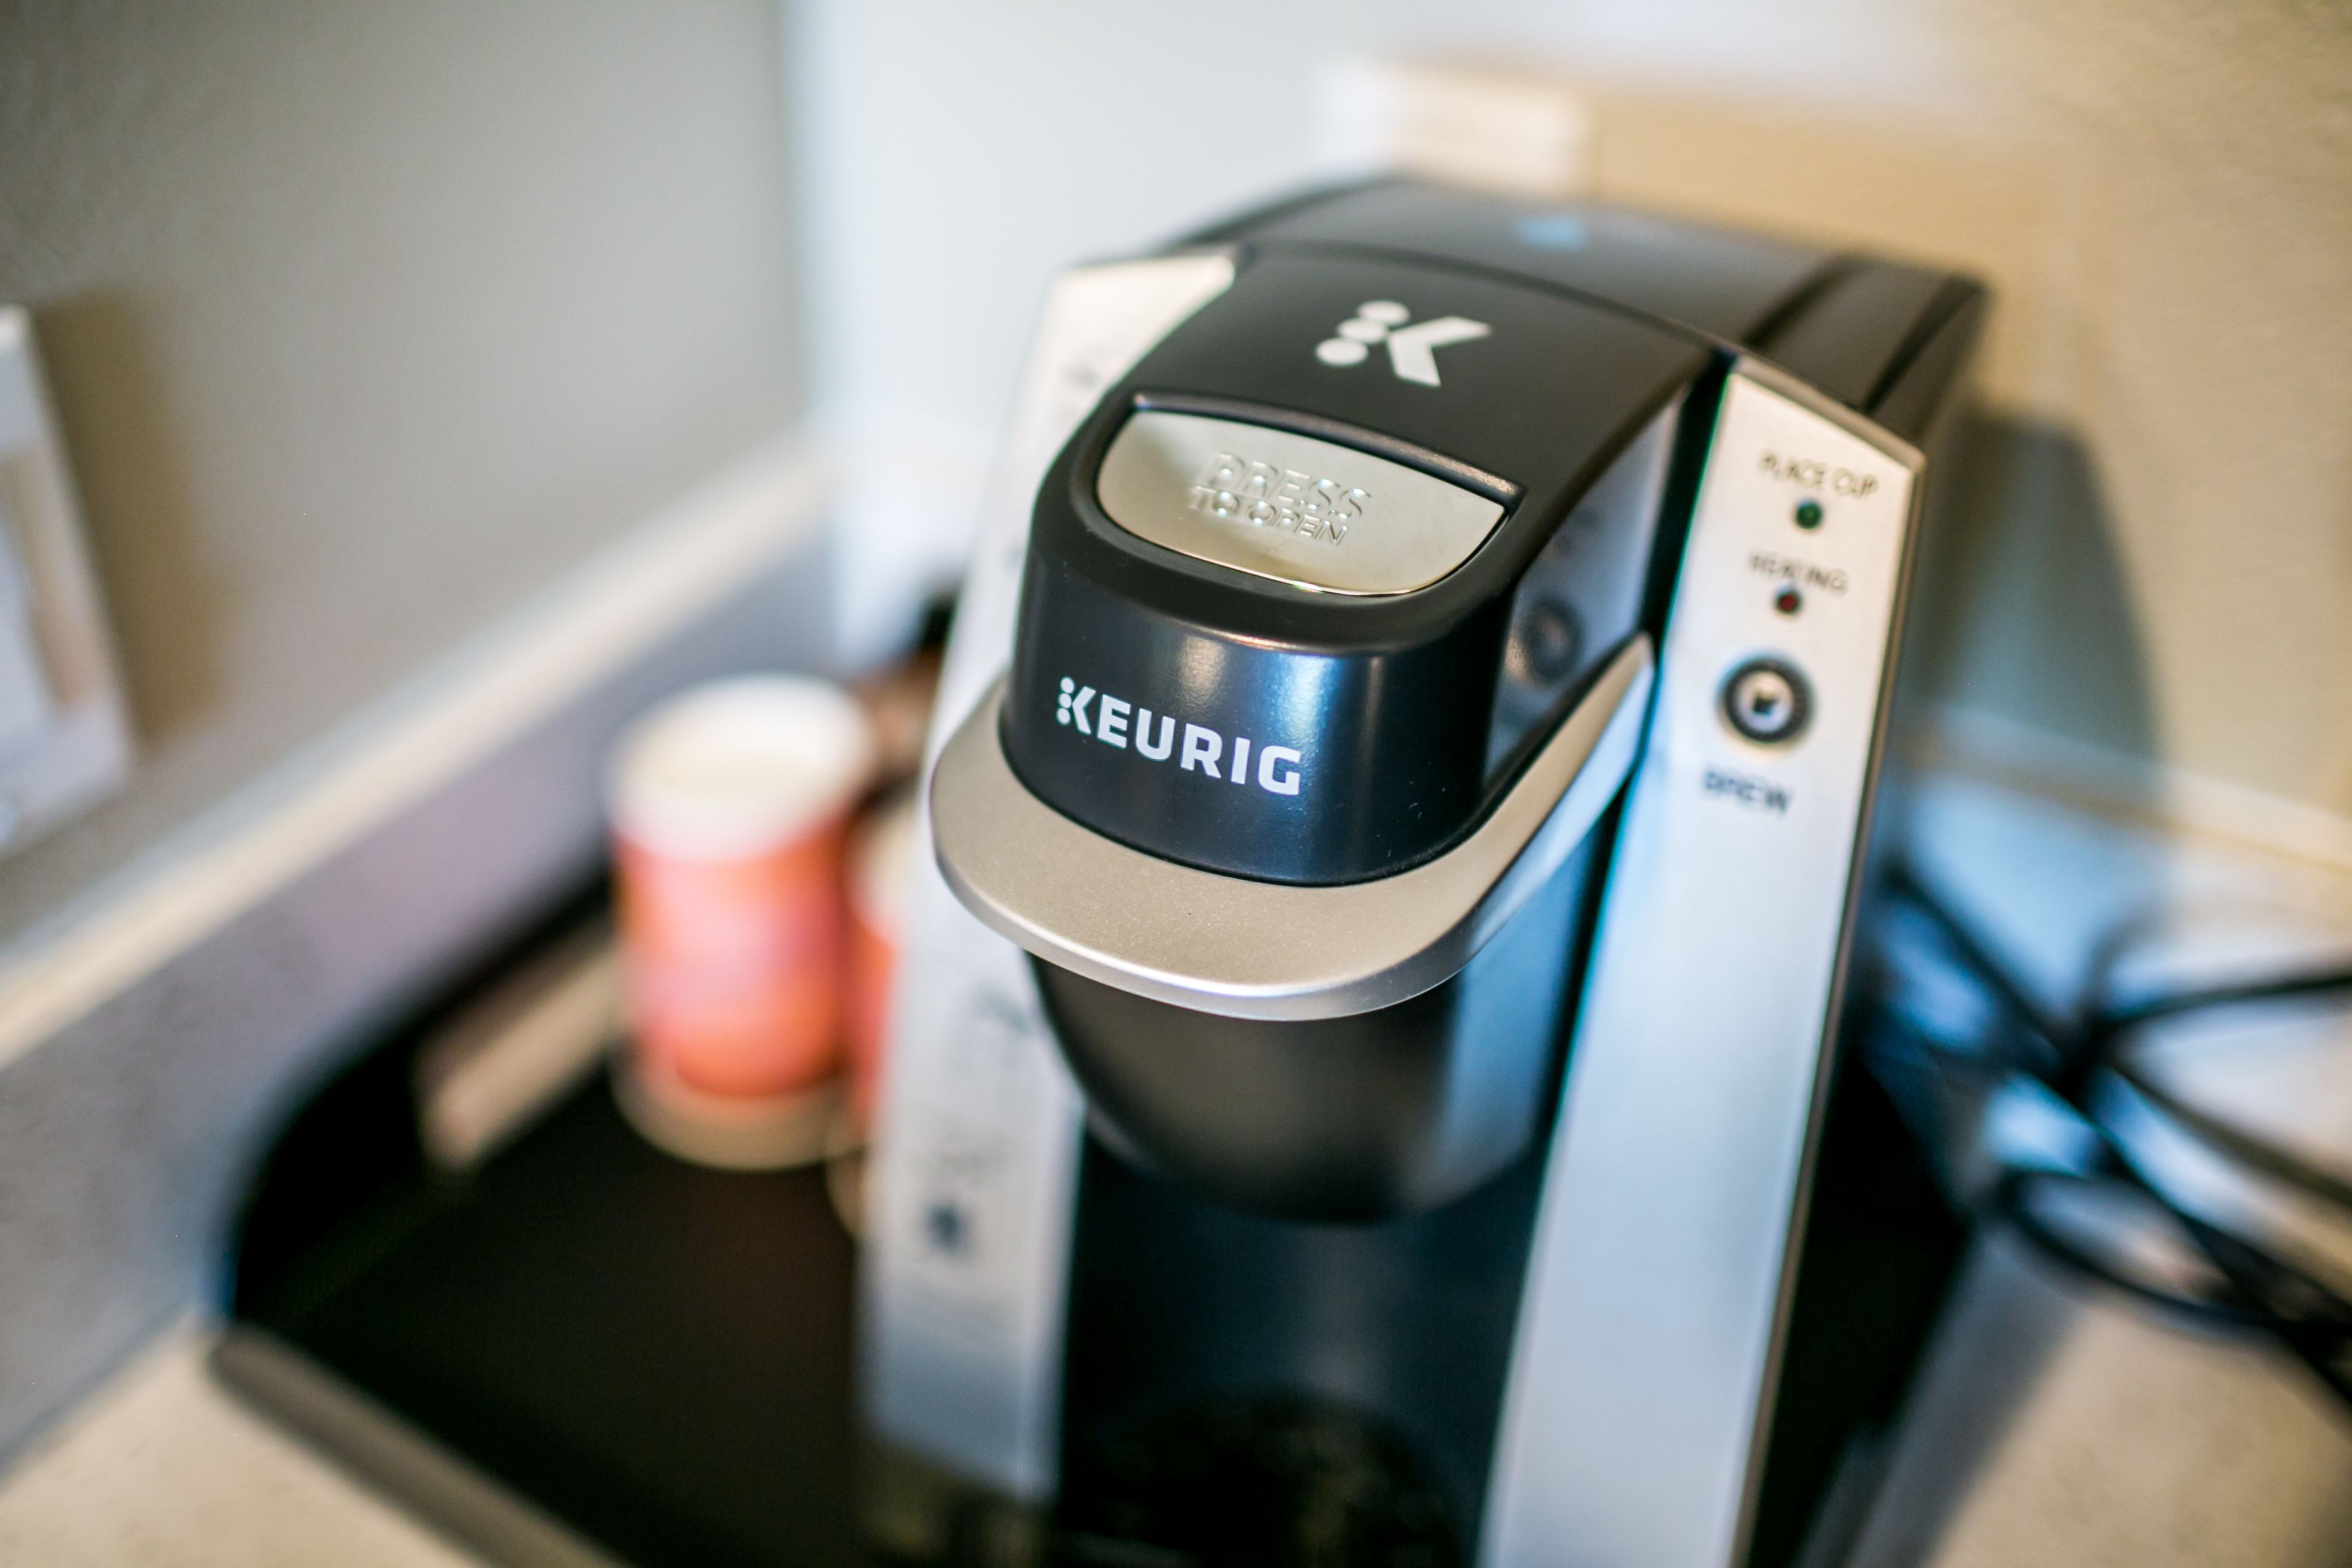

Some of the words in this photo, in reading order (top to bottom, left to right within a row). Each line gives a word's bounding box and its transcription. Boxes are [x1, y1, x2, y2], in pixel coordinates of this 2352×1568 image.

[1196, 453, 1372, 520] PRESS
[1758, 450, 1828, 491] PLACE
[1833, 467, 1879, 499] CUP
[1188, 485, 1240, 518] TO
[1247, 500, 1349, 546] OPEN
[1057, 677, 1301, 796] KEURIG
[1702, 763, 1795, 817] BREW
